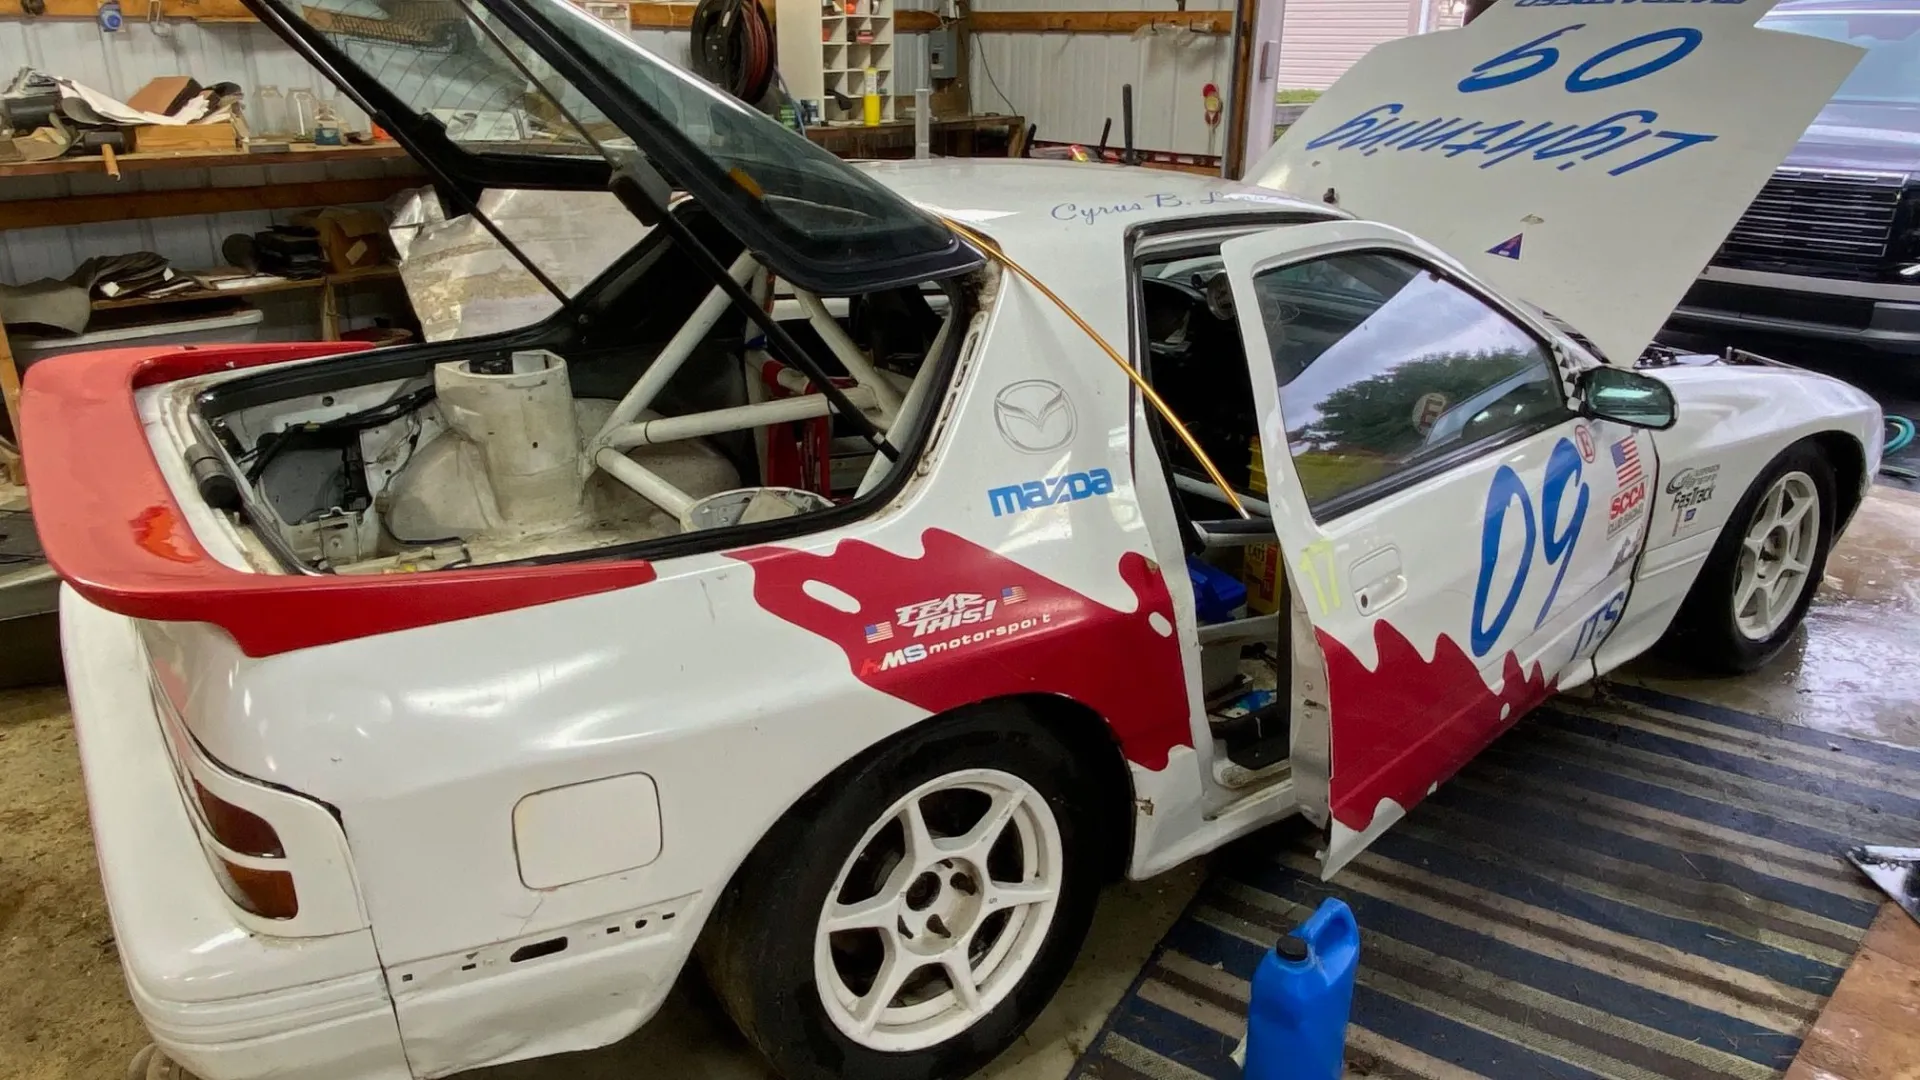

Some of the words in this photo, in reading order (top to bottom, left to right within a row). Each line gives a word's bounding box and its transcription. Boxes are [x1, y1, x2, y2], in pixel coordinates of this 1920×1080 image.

[1458, 23, 1703, 93] 09
[1305, 103, 1719, 176] Lightning
[1051, 202, 1144, 225] Cyrus
[1146, 193, 1192, 208] B.
[1609, 482, 1645, 520] SCCA
[1471, 437, 1589, 657] 09
[901, 599, 997, 638] THIS!
[1568, 591, 1625, 663] ITS
